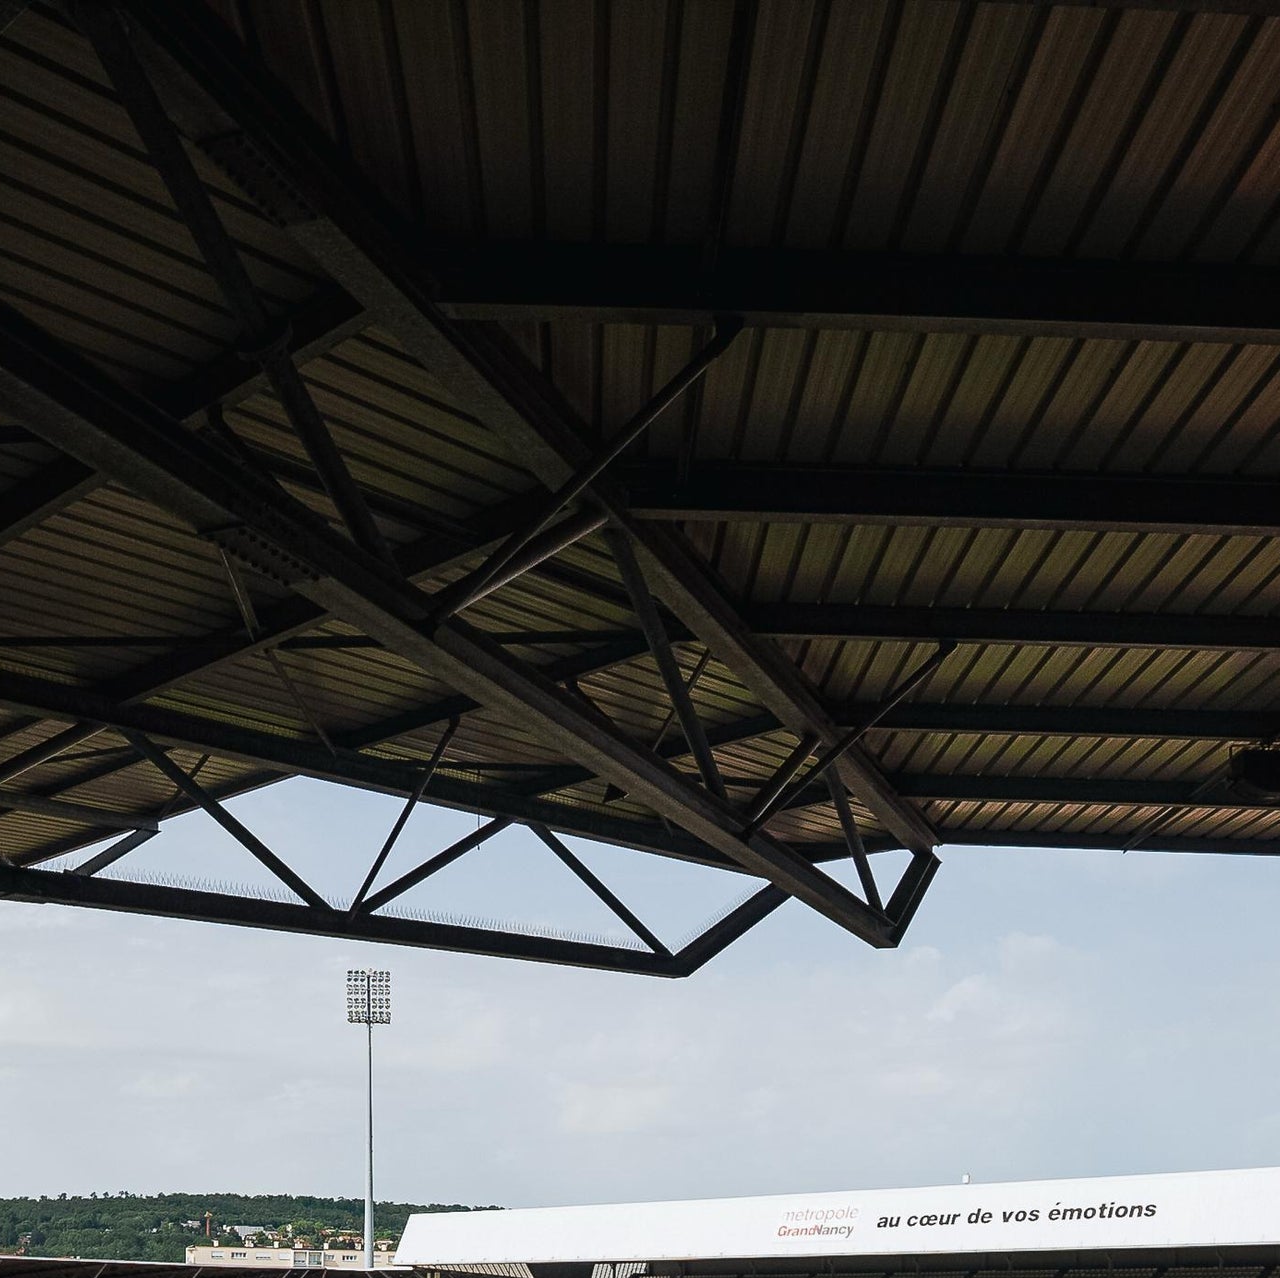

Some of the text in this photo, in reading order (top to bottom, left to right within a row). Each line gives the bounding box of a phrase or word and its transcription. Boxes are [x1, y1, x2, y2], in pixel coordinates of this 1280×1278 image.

[877, 1201, 1158, 1228] au cœur de vos émotions
